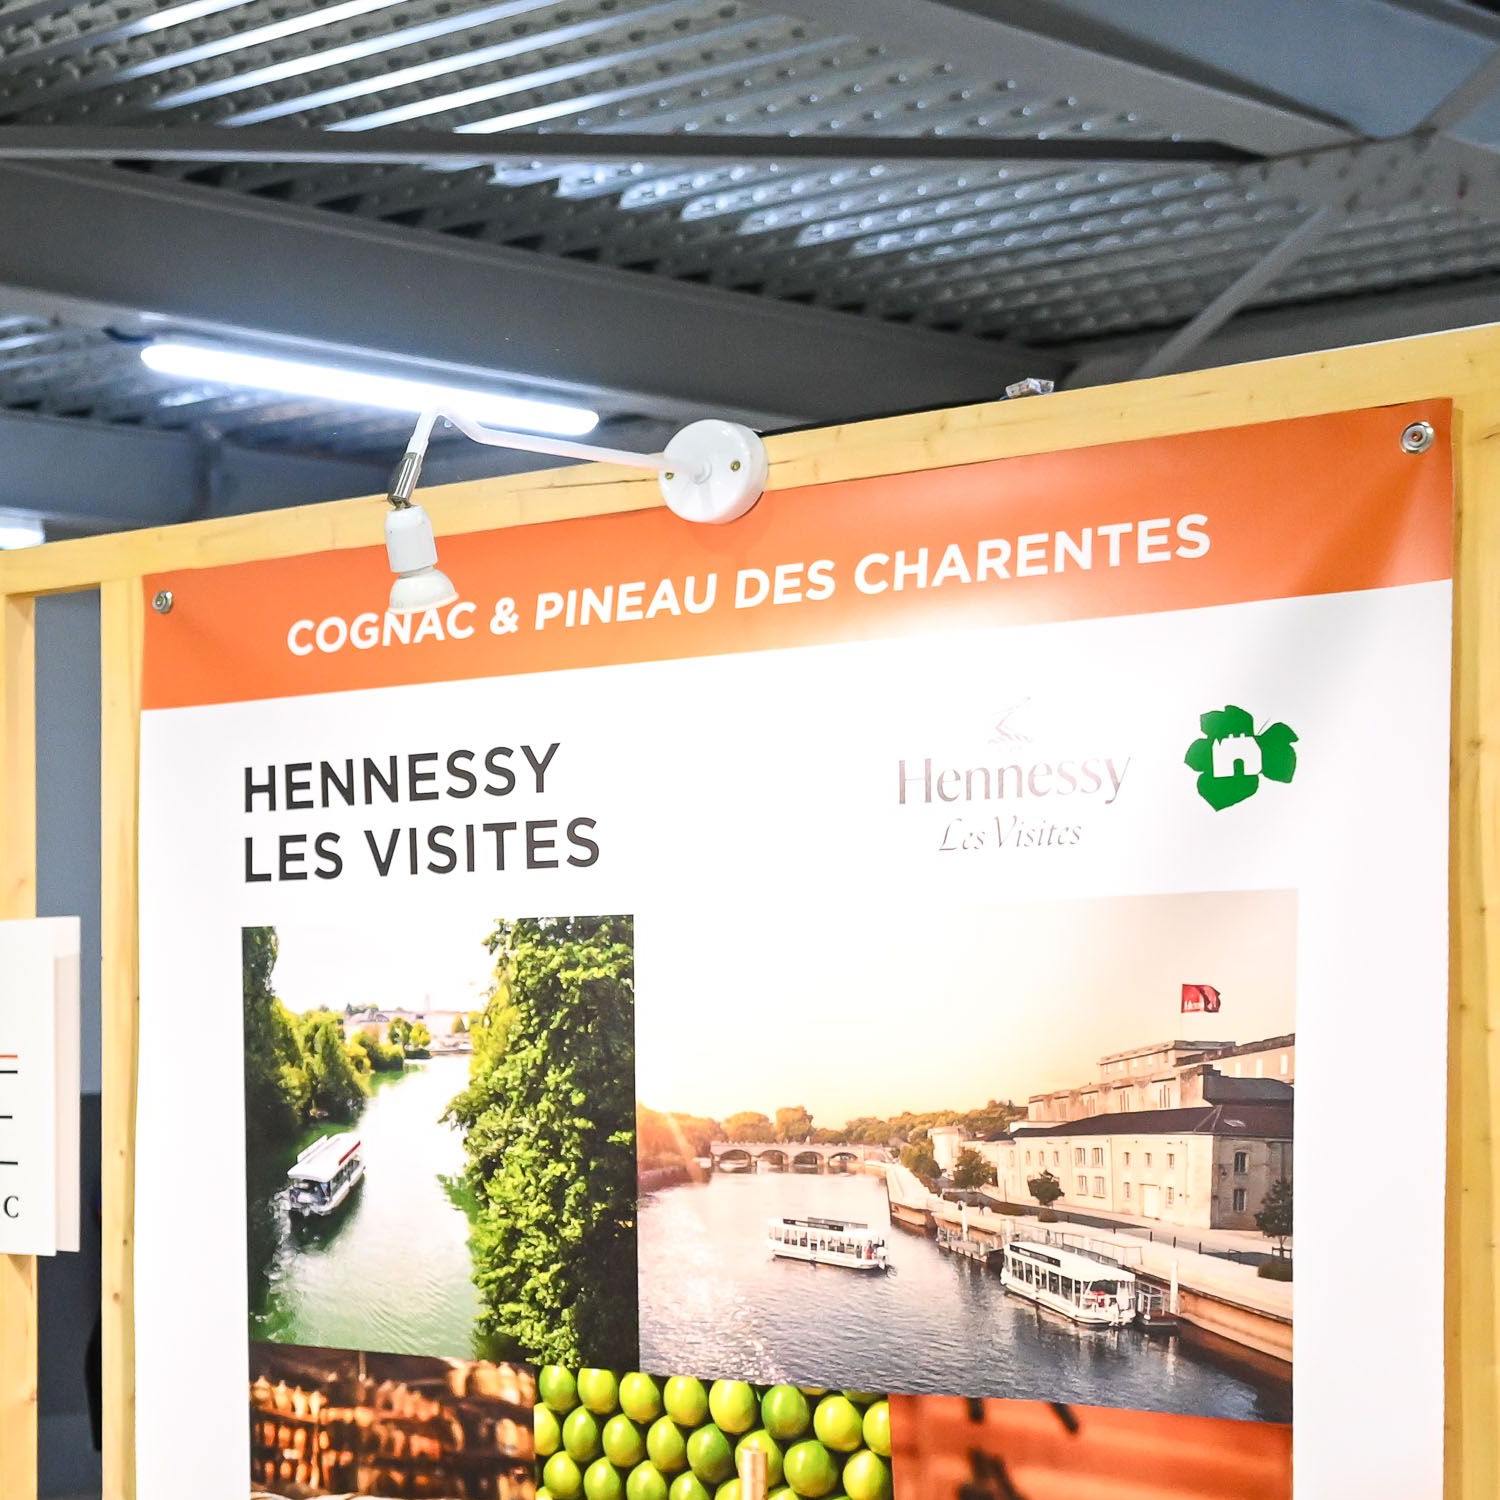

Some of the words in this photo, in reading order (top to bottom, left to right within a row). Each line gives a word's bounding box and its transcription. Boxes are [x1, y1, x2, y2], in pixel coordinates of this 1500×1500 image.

[287, 600, 477, 656] COGNAC
[490, 597, 520, 634] &
[535, 572, 717, 631] PINEAU
[734, 561, 836, 610] DES
[854, 513, 1212, 595] CHARENTES
[243, 742, 561, 814] HENNESSY
[898, 755, 1131, 806] Hennessy
[243, 831, 343, 884] LES
[364, 816, 600, 878] VISITES
[939, 817, 986, 852] Les
[993, 815, 1082, 849] Visites
